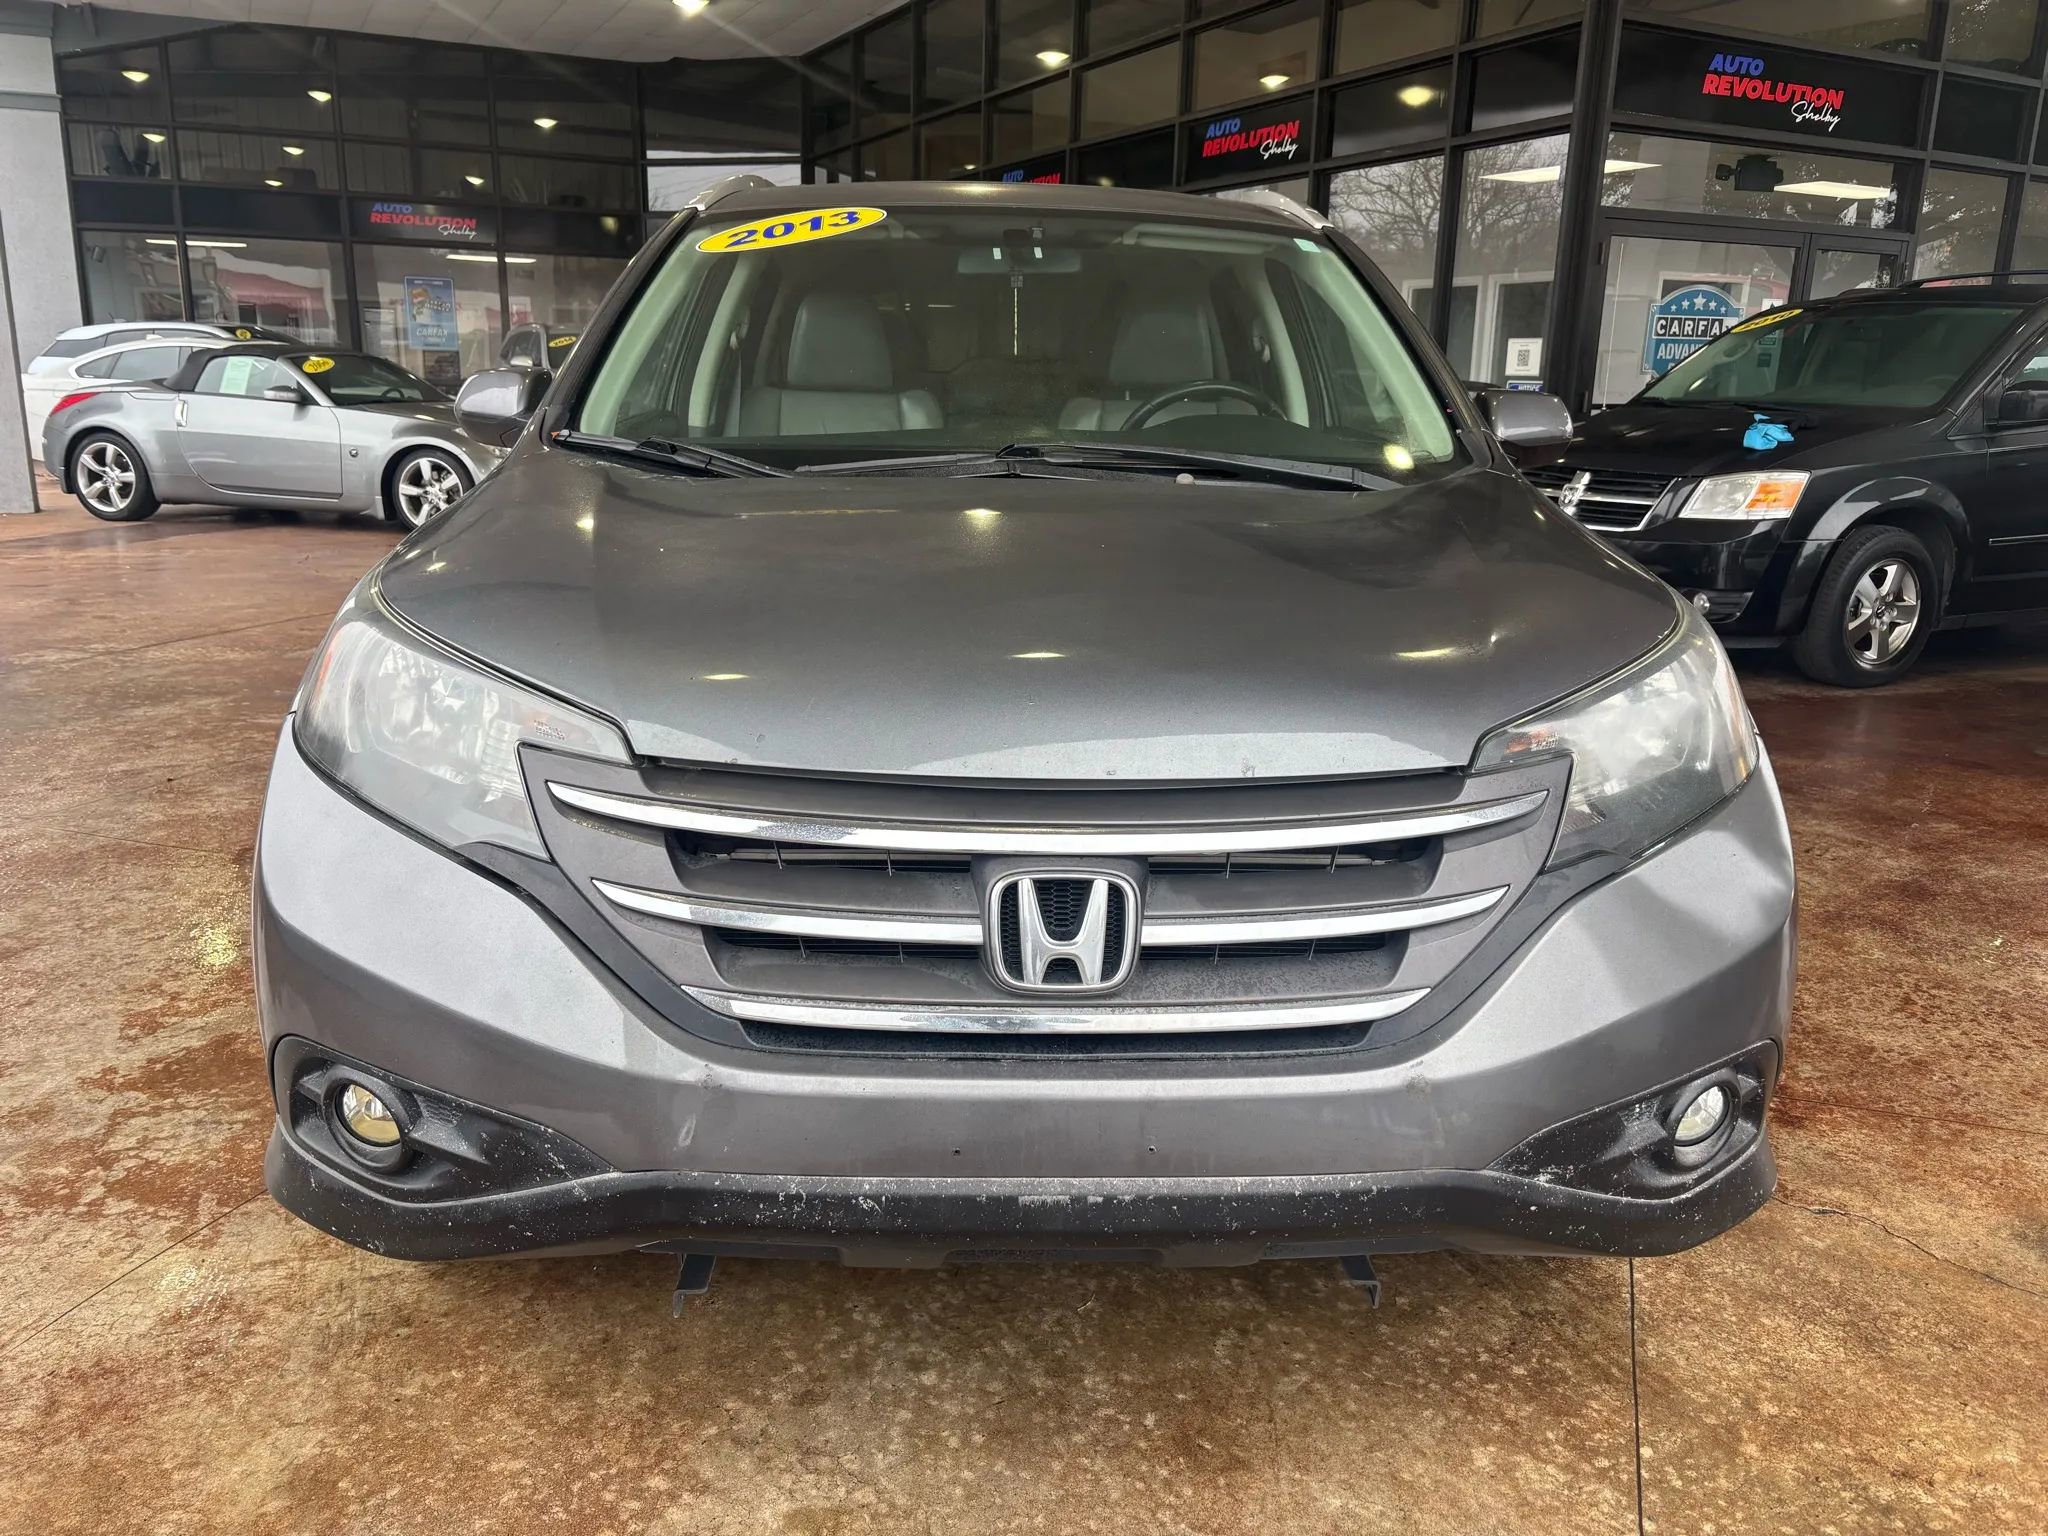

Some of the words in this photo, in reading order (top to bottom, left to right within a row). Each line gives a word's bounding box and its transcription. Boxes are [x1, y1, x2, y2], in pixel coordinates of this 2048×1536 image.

[1708, 53, 1764, 77] AUTO
[1702, 73, 1845, 110] REVOLUTION
[1791, 100, 1841, 132] Shelby
[1202, 119, 1300, 158] REVOLUTION
[1206, 118, 1241, 139] AUTO
[1260, 135, 1298, 160] Shelby
[372, 202, 413, 214] AUTO
[370, 212, 477, 229] REVOLUTION
[438, 224, 477, 240] Shelby
[725, 211, 862, 249] 2013
